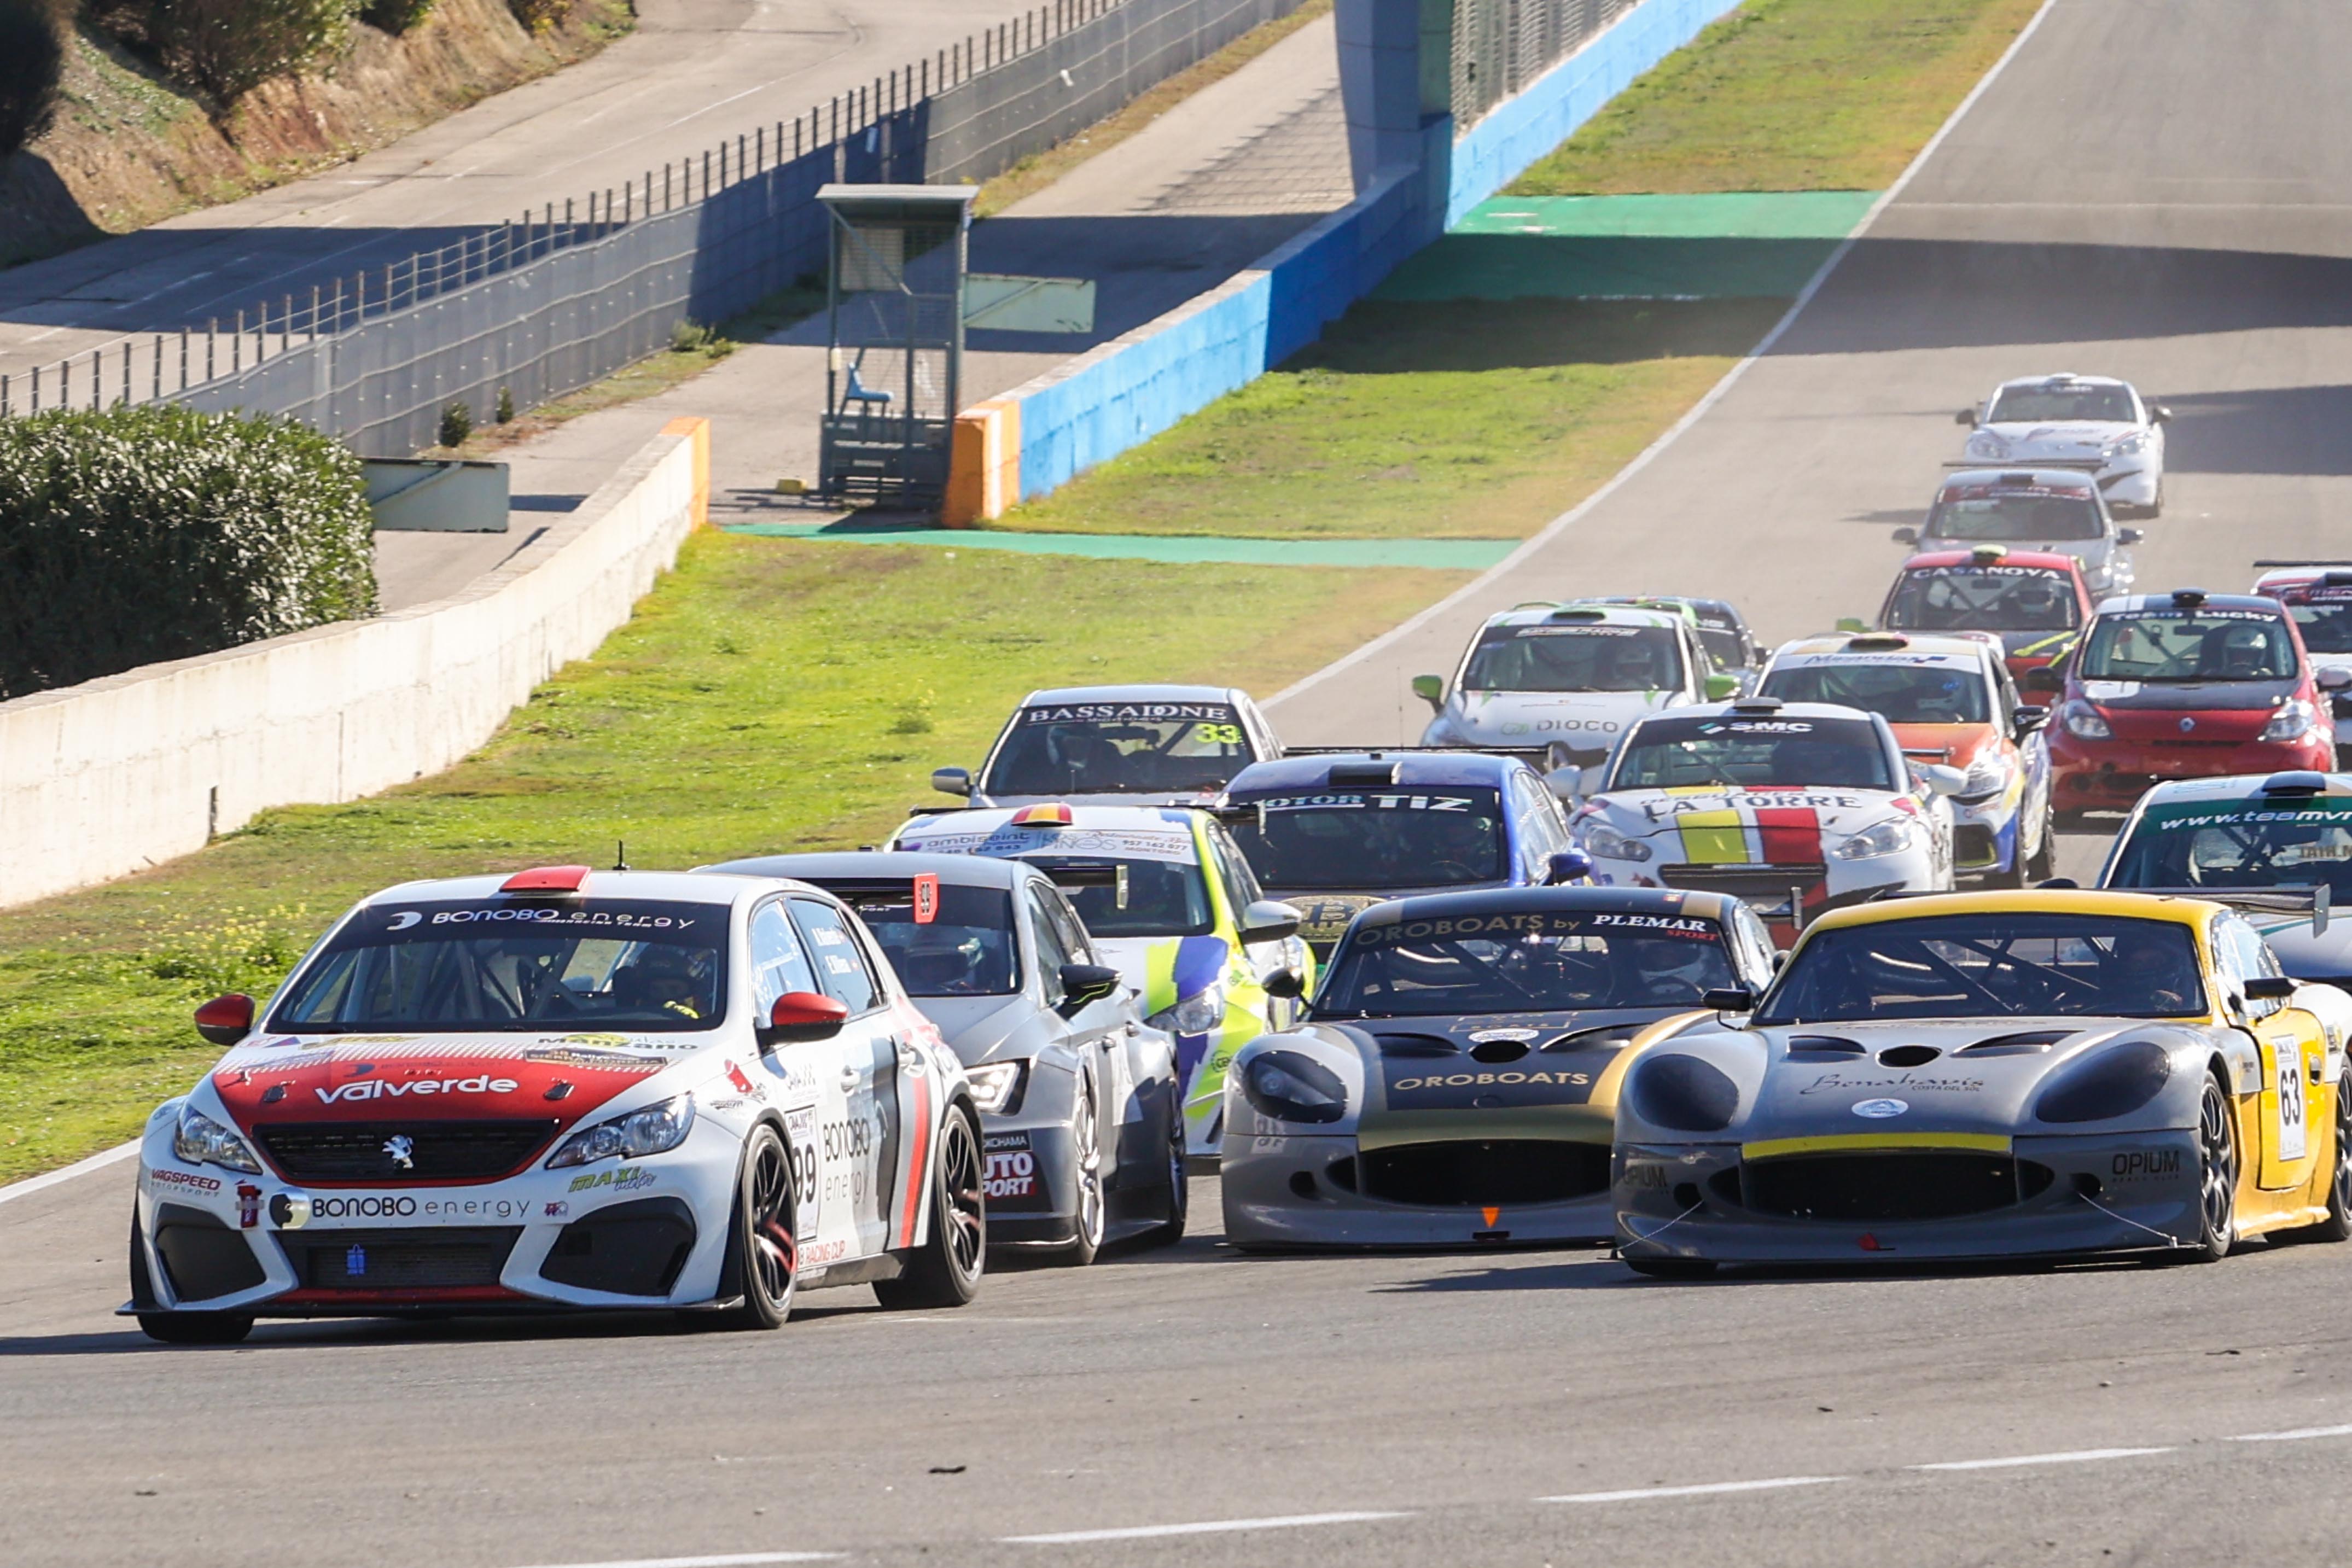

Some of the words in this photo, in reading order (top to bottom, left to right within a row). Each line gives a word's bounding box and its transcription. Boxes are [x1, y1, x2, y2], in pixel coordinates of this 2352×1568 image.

[1913, 567, 2060, 579] CASANOVA
[2195, 610, 2278, 622] Lucky
[1195, 724, 1240, 744] 33
[1728, 722, 1813, 732] SMC
[1370, 795, 1472, 812] TIZ
[1642, 800, 1699, 819] LA
[1718, 795, 1863, 813] TORRE
[571, 912, 695, 929] energy
[1355, 915, 1544, 945] OROBOATS
[1553, 919, 1581, 930] by
[1592, 914, 1707, 932] PLEMAR
[1666, 929, 1720, 941] SPORT
[315, 1075, 519, 1104] valverde
[1394, 1071, 1589, 1091] OROBOATS
[2280, 1068, 2301, 1127] 63
[983, 1152, 1034, 1180] UTO
[2112, 1149, 2180, 1175] OPIUM
[152, 1168, 221, 1191] VAGSPEED
[569, 1166, 642, 1193] MAXI
[982, 1176, 1034, 1197] PORT
[424, 1200, 531, 1217] energy
